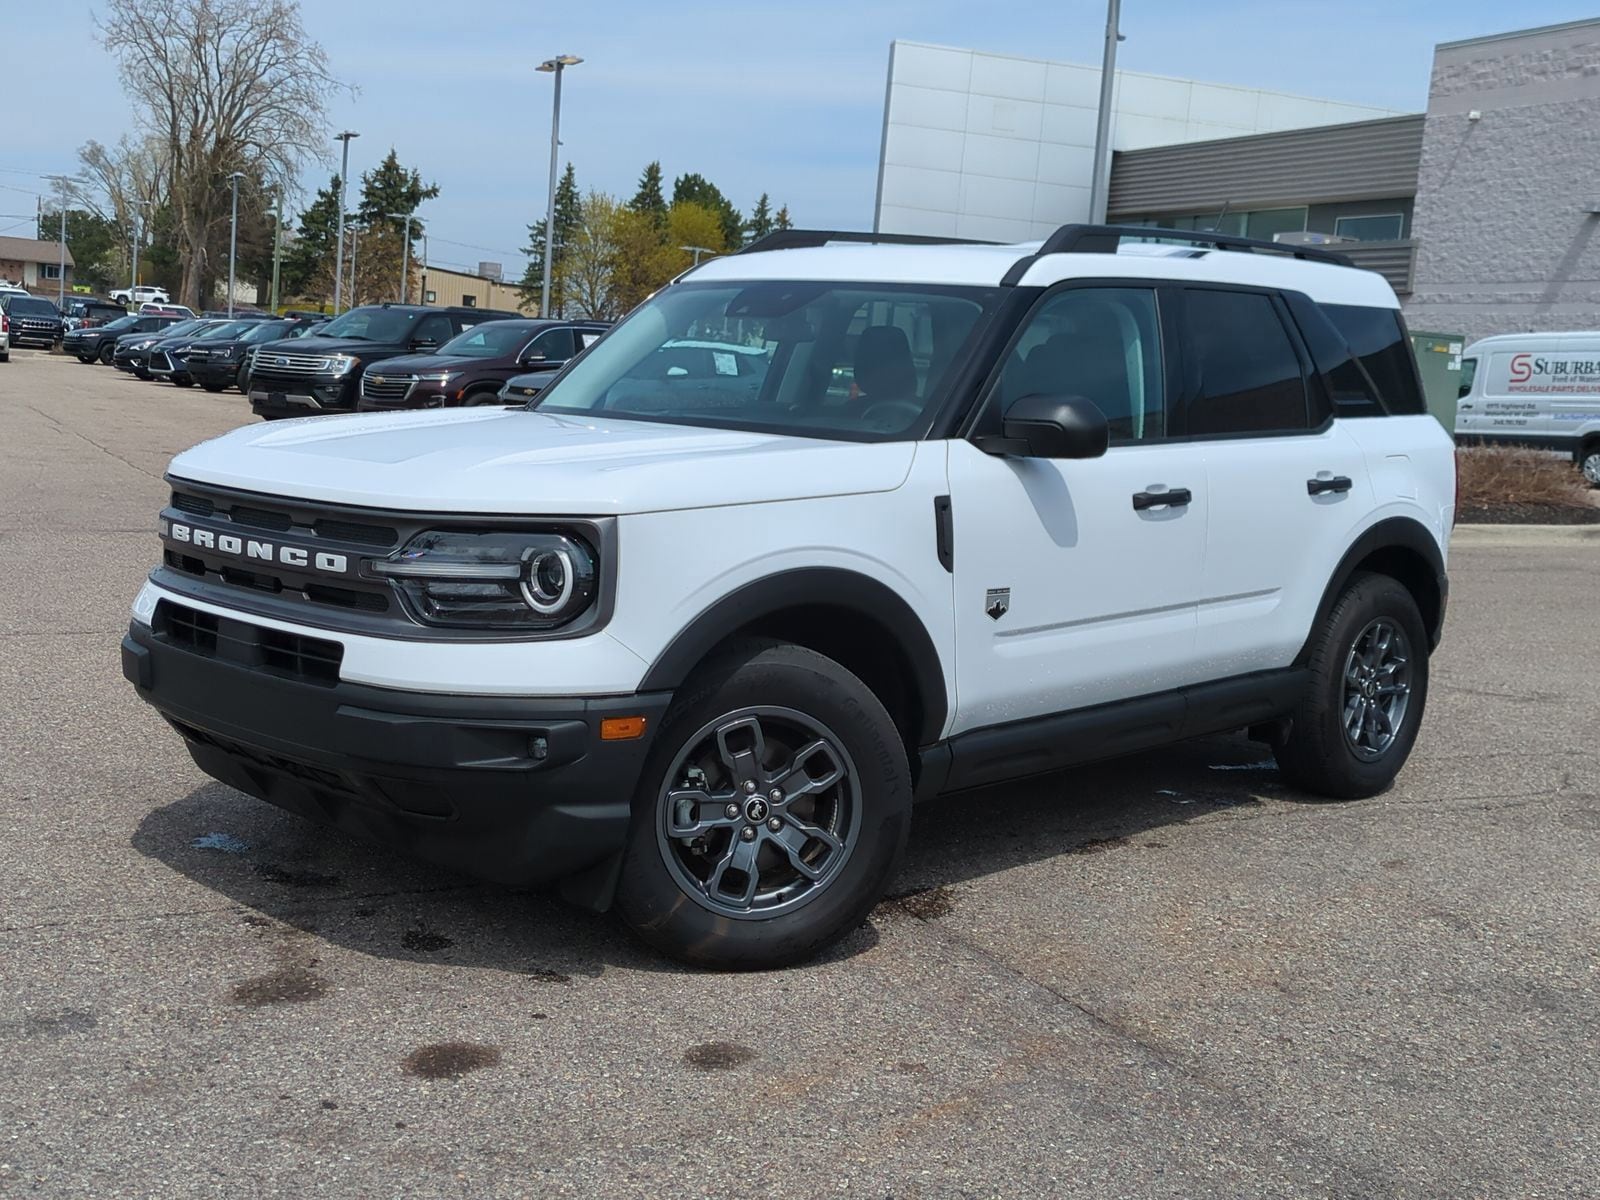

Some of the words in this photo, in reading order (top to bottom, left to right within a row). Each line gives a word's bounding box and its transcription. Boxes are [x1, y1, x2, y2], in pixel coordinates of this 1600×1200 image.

[1508, 385, 1550, 393] WHOLESALE
[1551, 385, 1574, 393] PARTS
[171, 523, 348, 573] BRONCO
